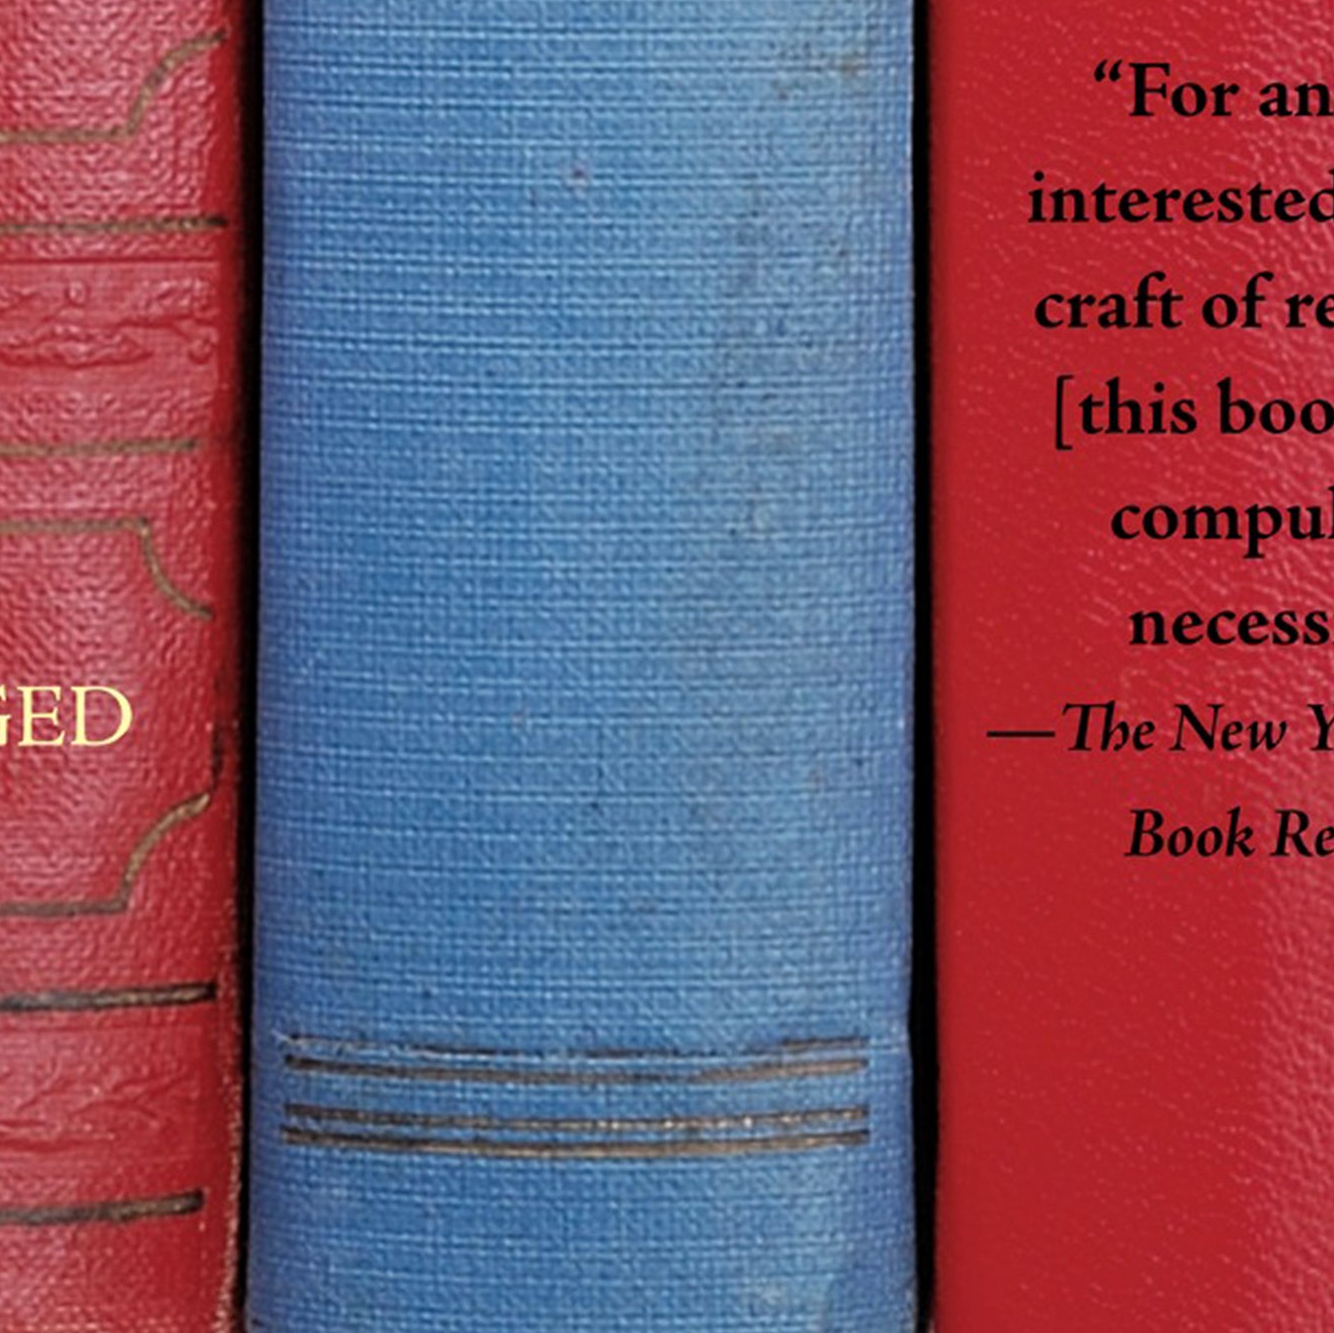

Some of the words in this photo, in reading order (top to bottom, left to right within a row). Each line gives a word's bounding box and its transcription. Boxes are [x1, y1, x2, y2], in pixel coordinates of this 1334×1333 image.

[1093, 58, 1240, 118] “For
[1034, 271, 1183, 330] craft
[1201, 271, 1275, 330] of
[1054, 374, 1197, 451] [this
[1171, 702, 1288, 753] New
[1123, 806, 1256, 859] Book
